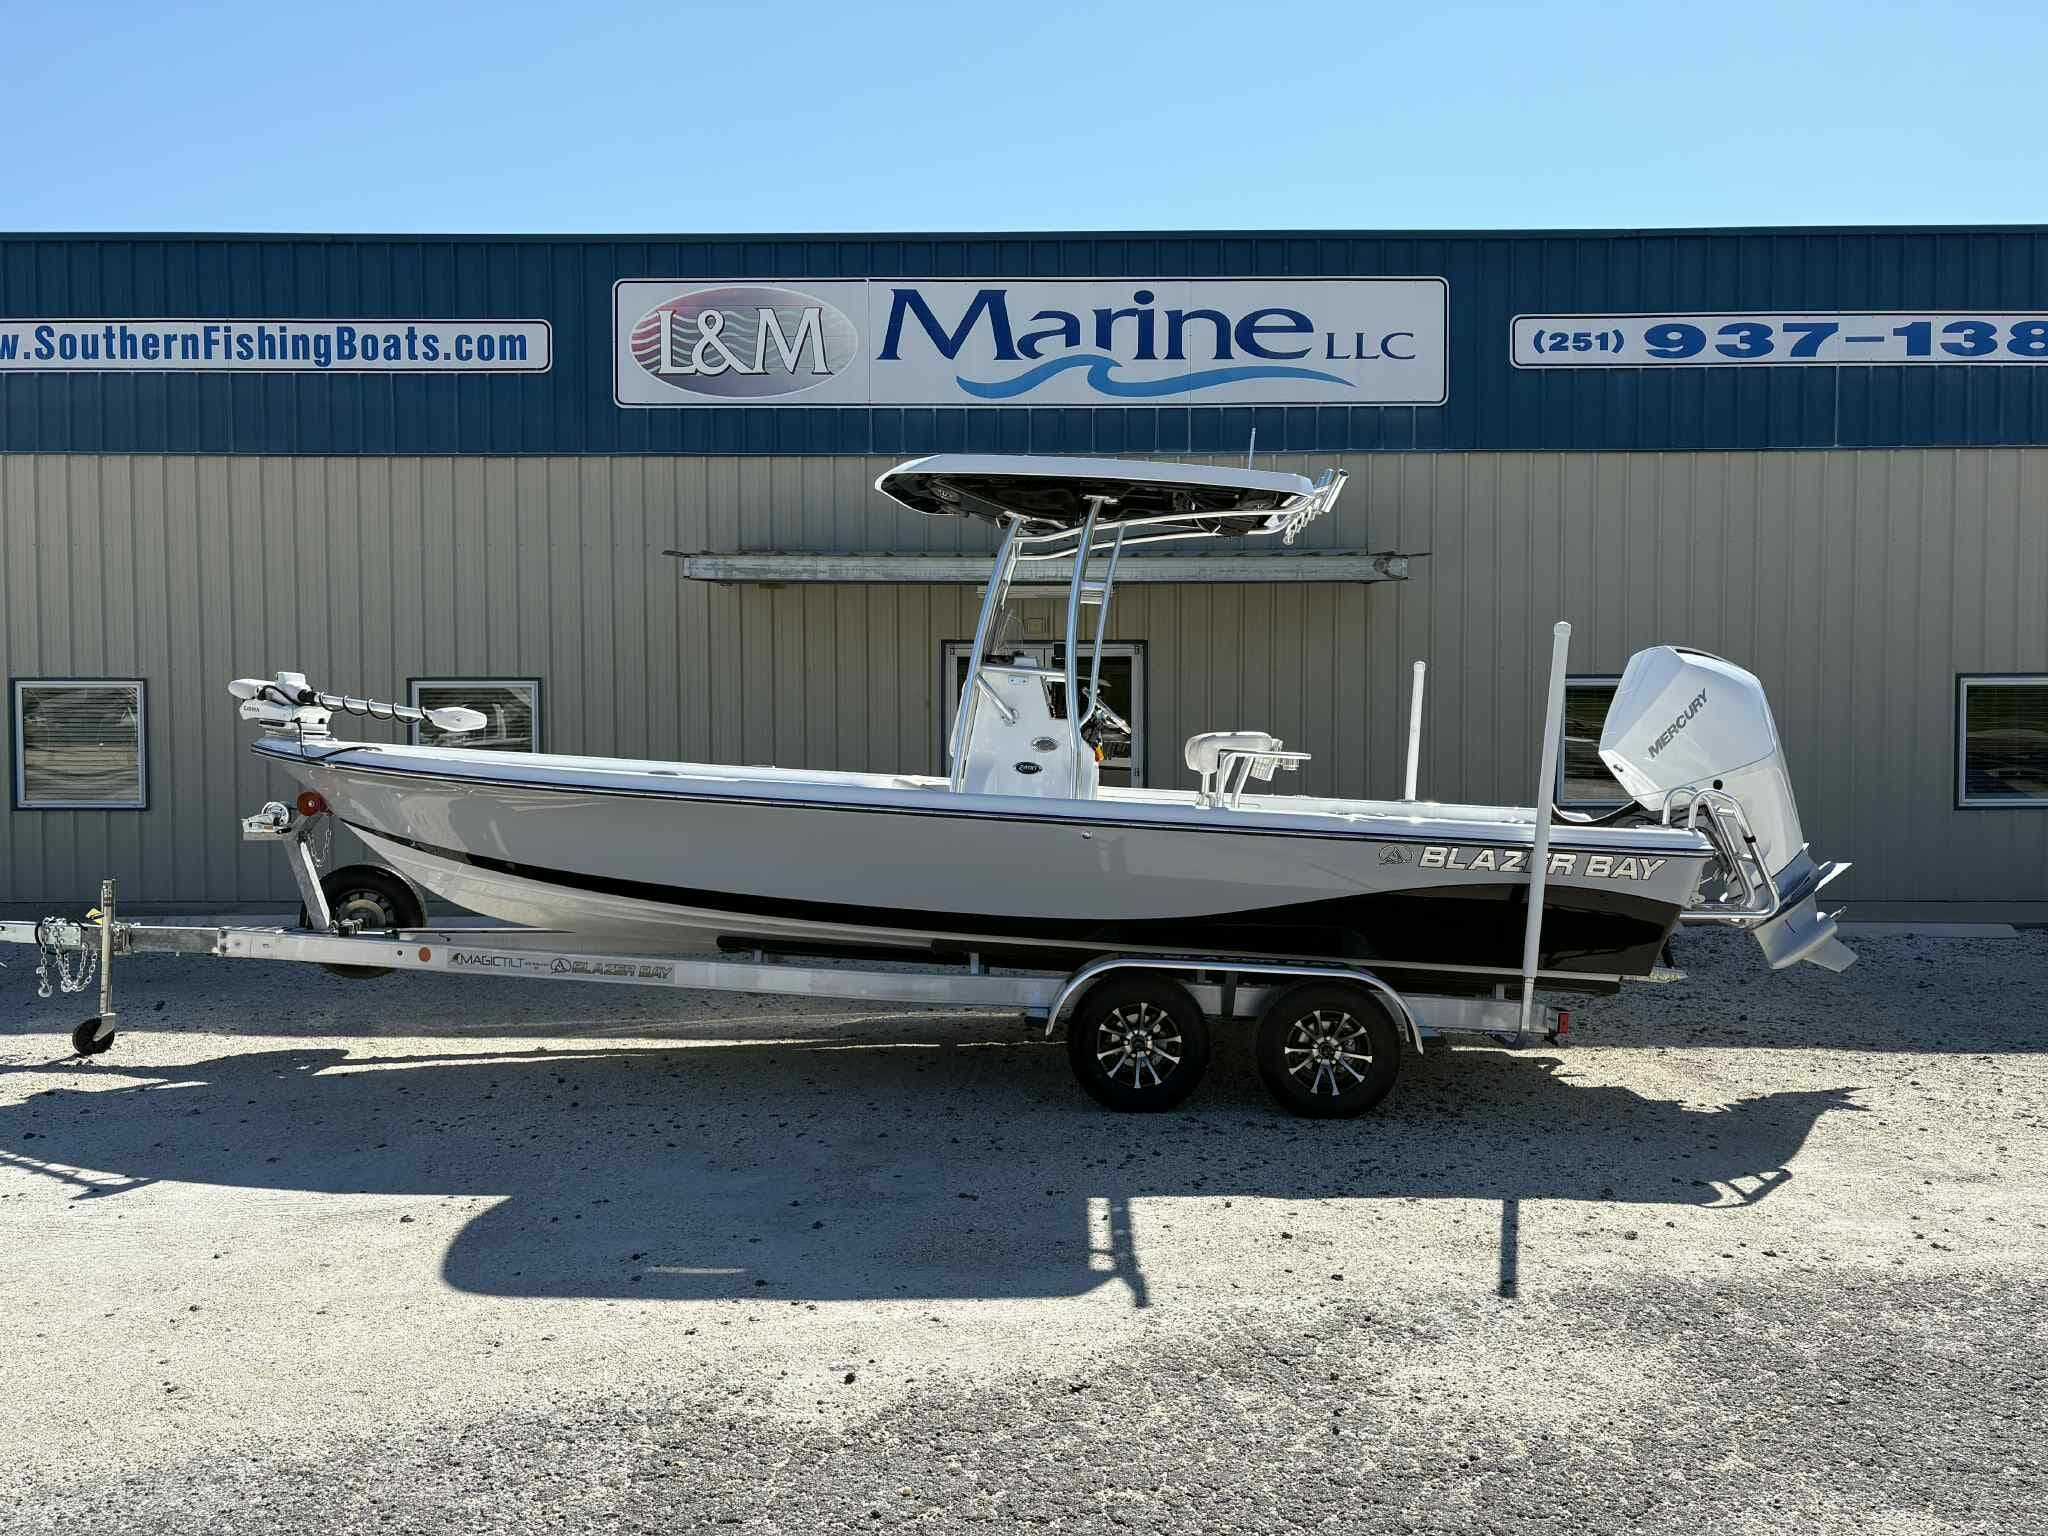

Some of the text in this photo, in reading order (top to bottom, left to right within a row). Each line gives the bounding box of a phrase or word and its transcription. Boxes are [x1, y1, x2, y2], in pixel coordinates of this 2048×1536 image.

[657, 288, 1417, 377] L&M Marine LLC
[1533, 328, 1625, 355] (251)
[1648, 687, 1709, 758] MERCURY
[1583, 854, 1668, 881] BAY
